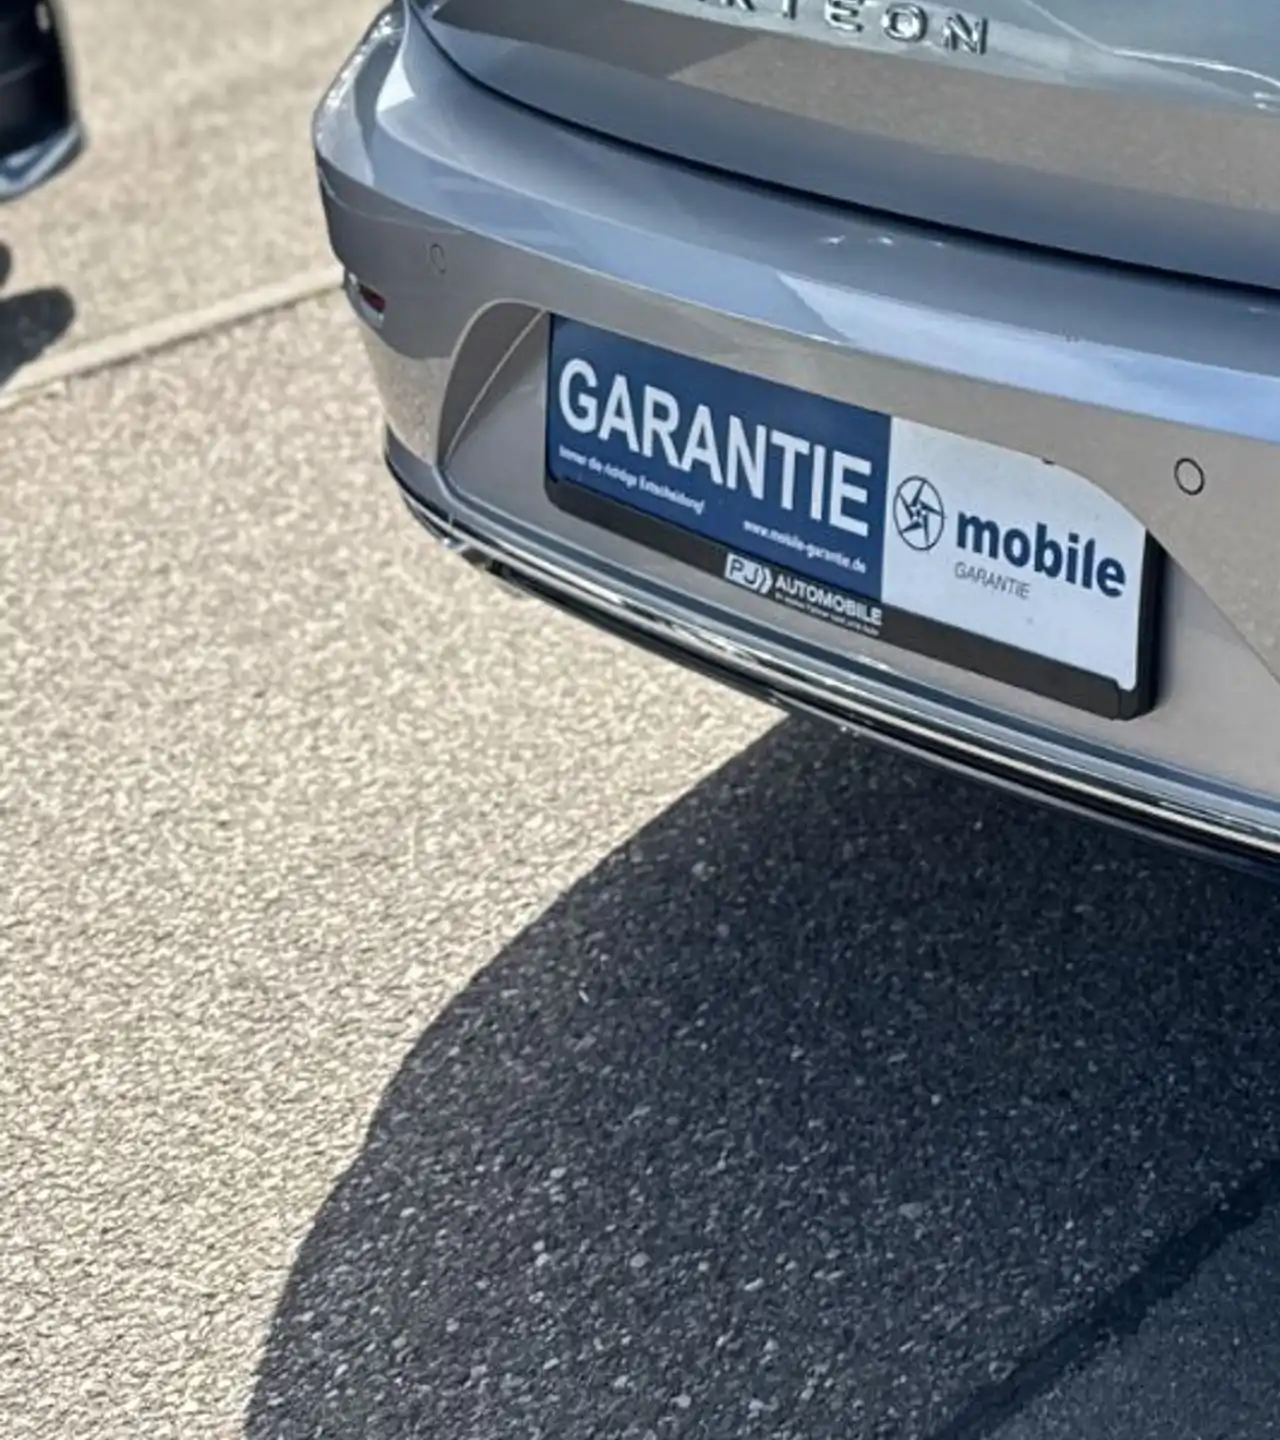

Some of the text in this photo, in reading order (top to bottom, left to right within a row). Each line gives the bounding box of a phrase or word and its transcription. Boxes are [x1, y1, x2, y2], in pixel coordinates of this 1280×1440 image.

[558, 358, 872, 537] GARANTIE
[954, 561, 1031, 600] GARANTIE
[956, 511, 1126, 599] mobile
[775, 573, 883, 627] AUTOMOBILE
